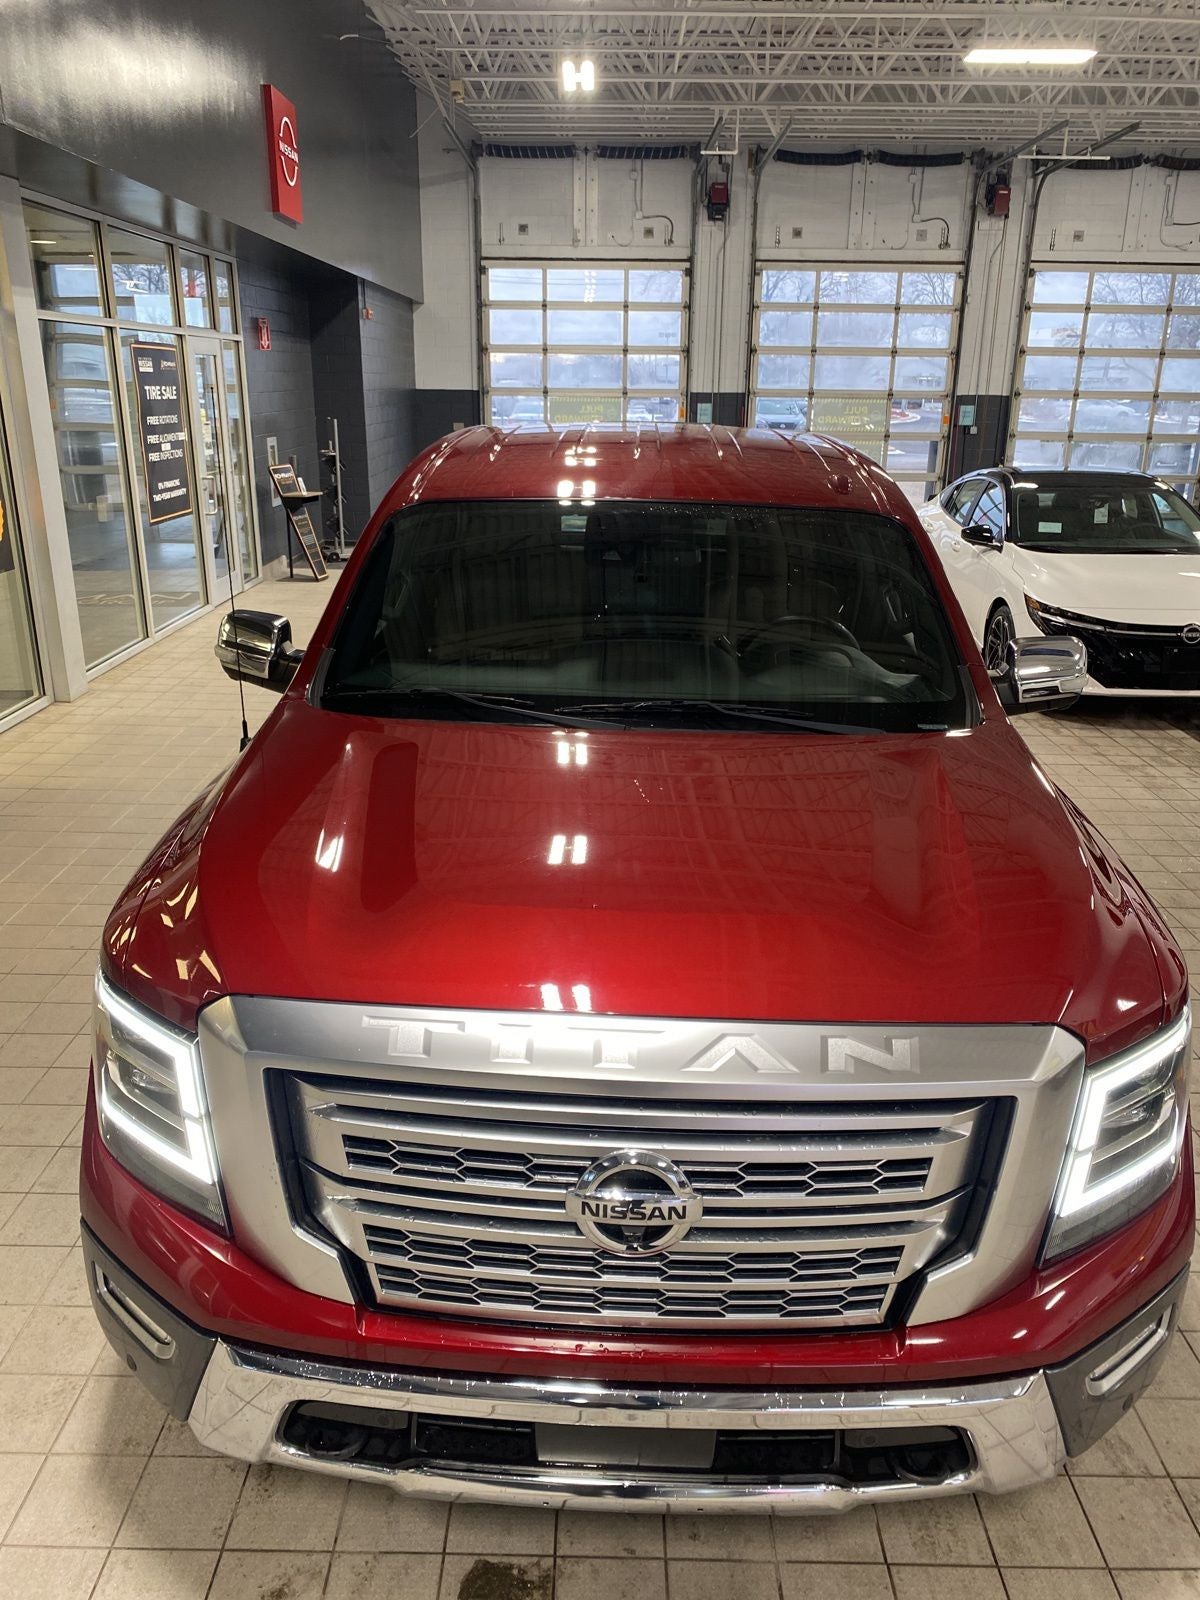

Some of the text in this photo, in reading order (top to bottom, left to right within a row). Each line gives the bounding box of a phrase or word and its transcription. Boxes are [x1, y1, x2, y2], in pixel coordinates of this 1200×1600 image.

[279, 140, 299, 163] NISSAN
[144, 386, 177, 400] TIRE SALE
[147, 416, 160, 425] FREE
[147, 434, 160, 444] FREE
[148, 449, 183, 462] FREE INSPECTIONS
[362, 1014, 920, 1074] TITAN
[581, 1201, 687, 1221] NISSAN
